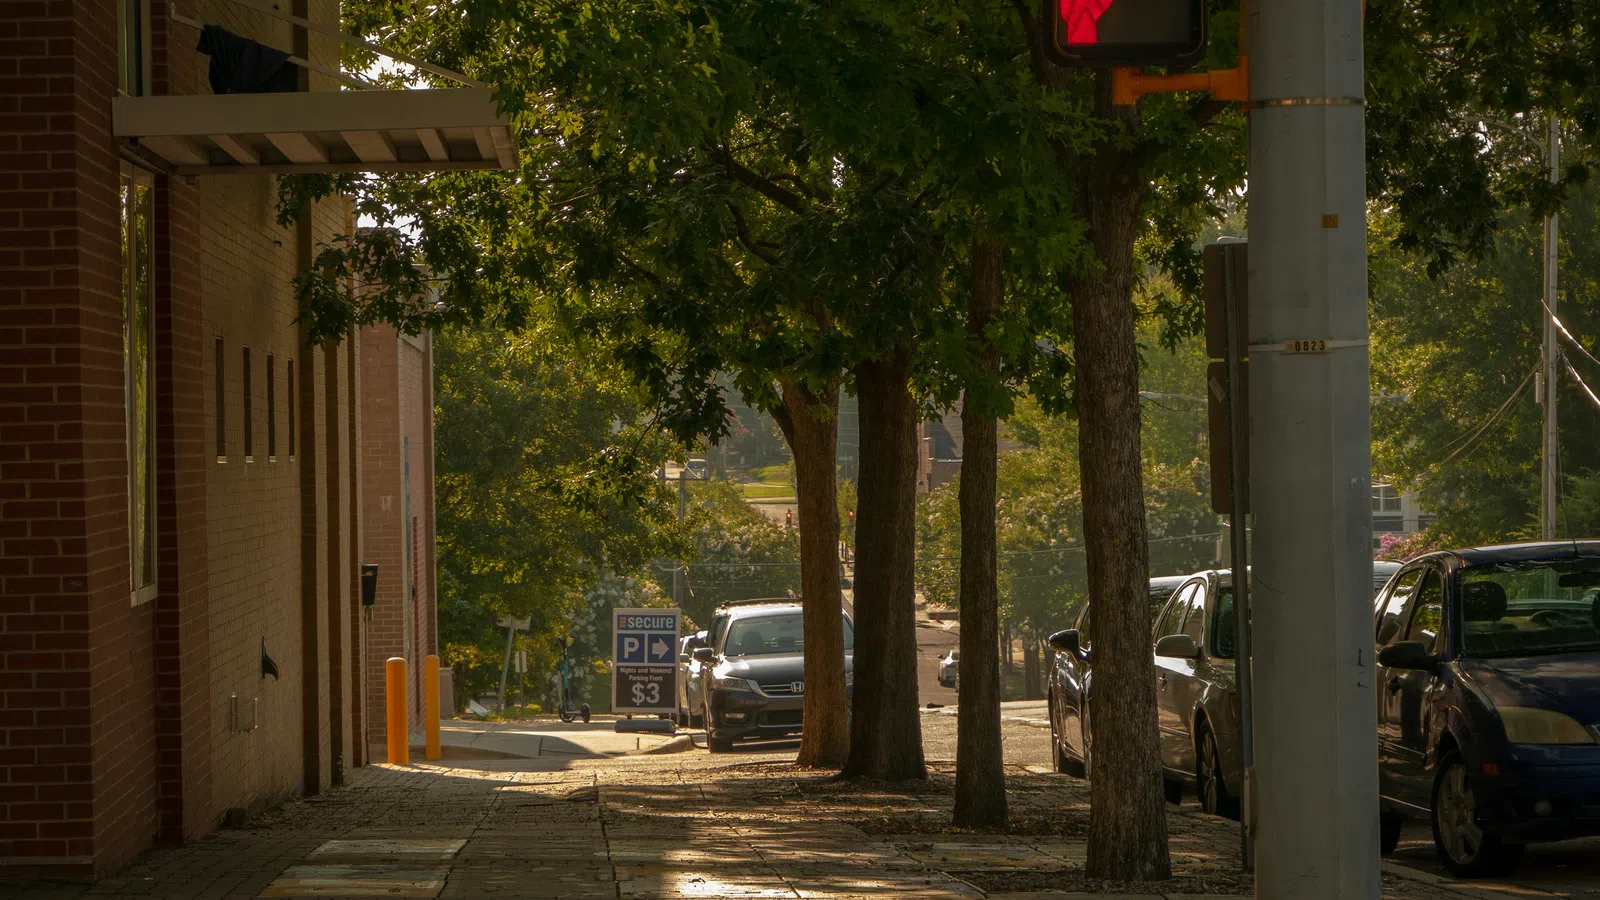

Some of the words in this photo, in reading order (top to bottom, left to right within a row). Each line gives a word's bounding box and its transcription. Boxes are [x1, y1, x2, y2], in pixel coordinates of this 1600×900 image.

[1295, 340, 1325, 351] 0823
[628, 616, 673, 629] secure
[624, 637, 639, 659] P
[628, 674, 648, 682] Parking
[632, 682, 660, 706] $3
